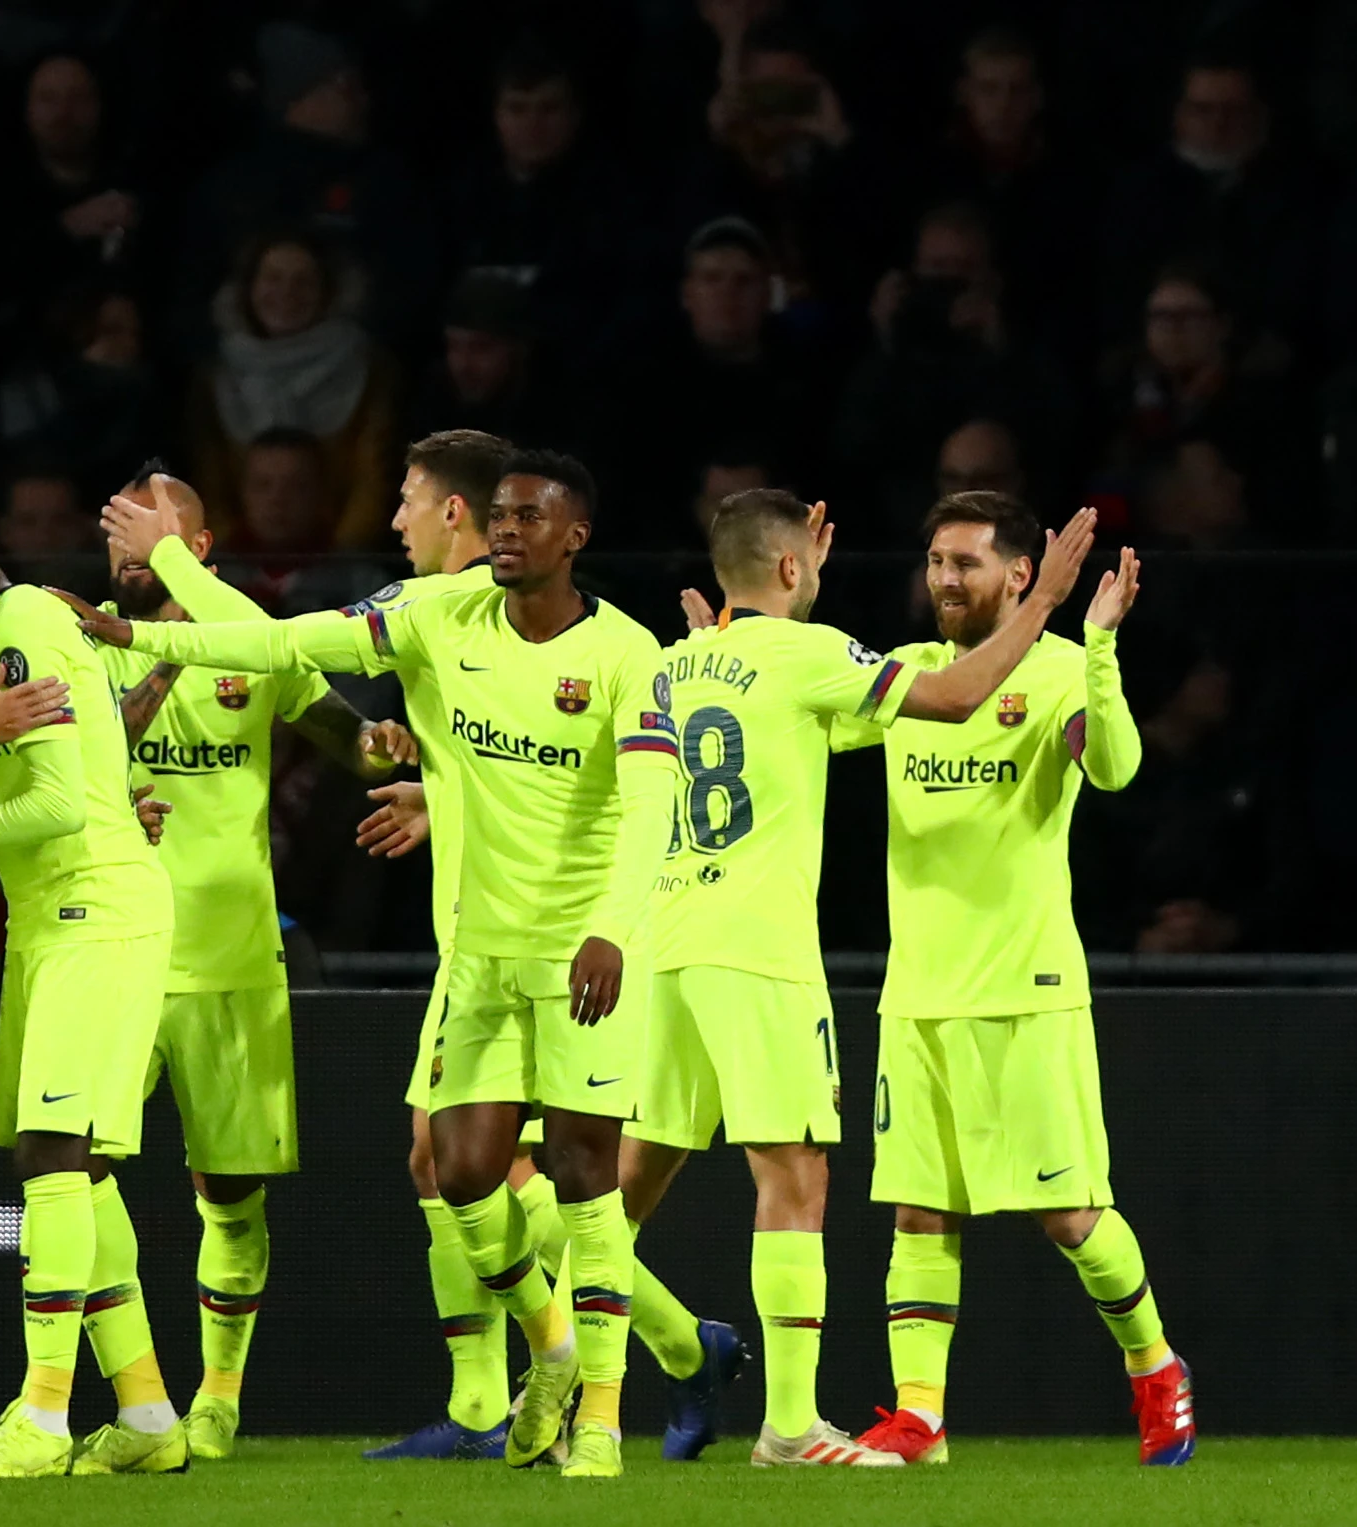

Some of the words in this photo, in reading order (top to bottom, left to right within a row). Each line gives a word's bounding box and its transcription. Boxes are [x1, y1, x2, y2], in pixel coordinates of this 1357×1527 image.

[700, 652, 758, 696] ALBA
[131, 735, 250, 768] akuten
[452, 708, 581, 768] Rakuten
[666, 705, 753, 860] 8
[904, 753, 1018, 784] Rakuten
[815, 1017, 833, 1077] 1
[876, 1074, 891, 1134] 0
